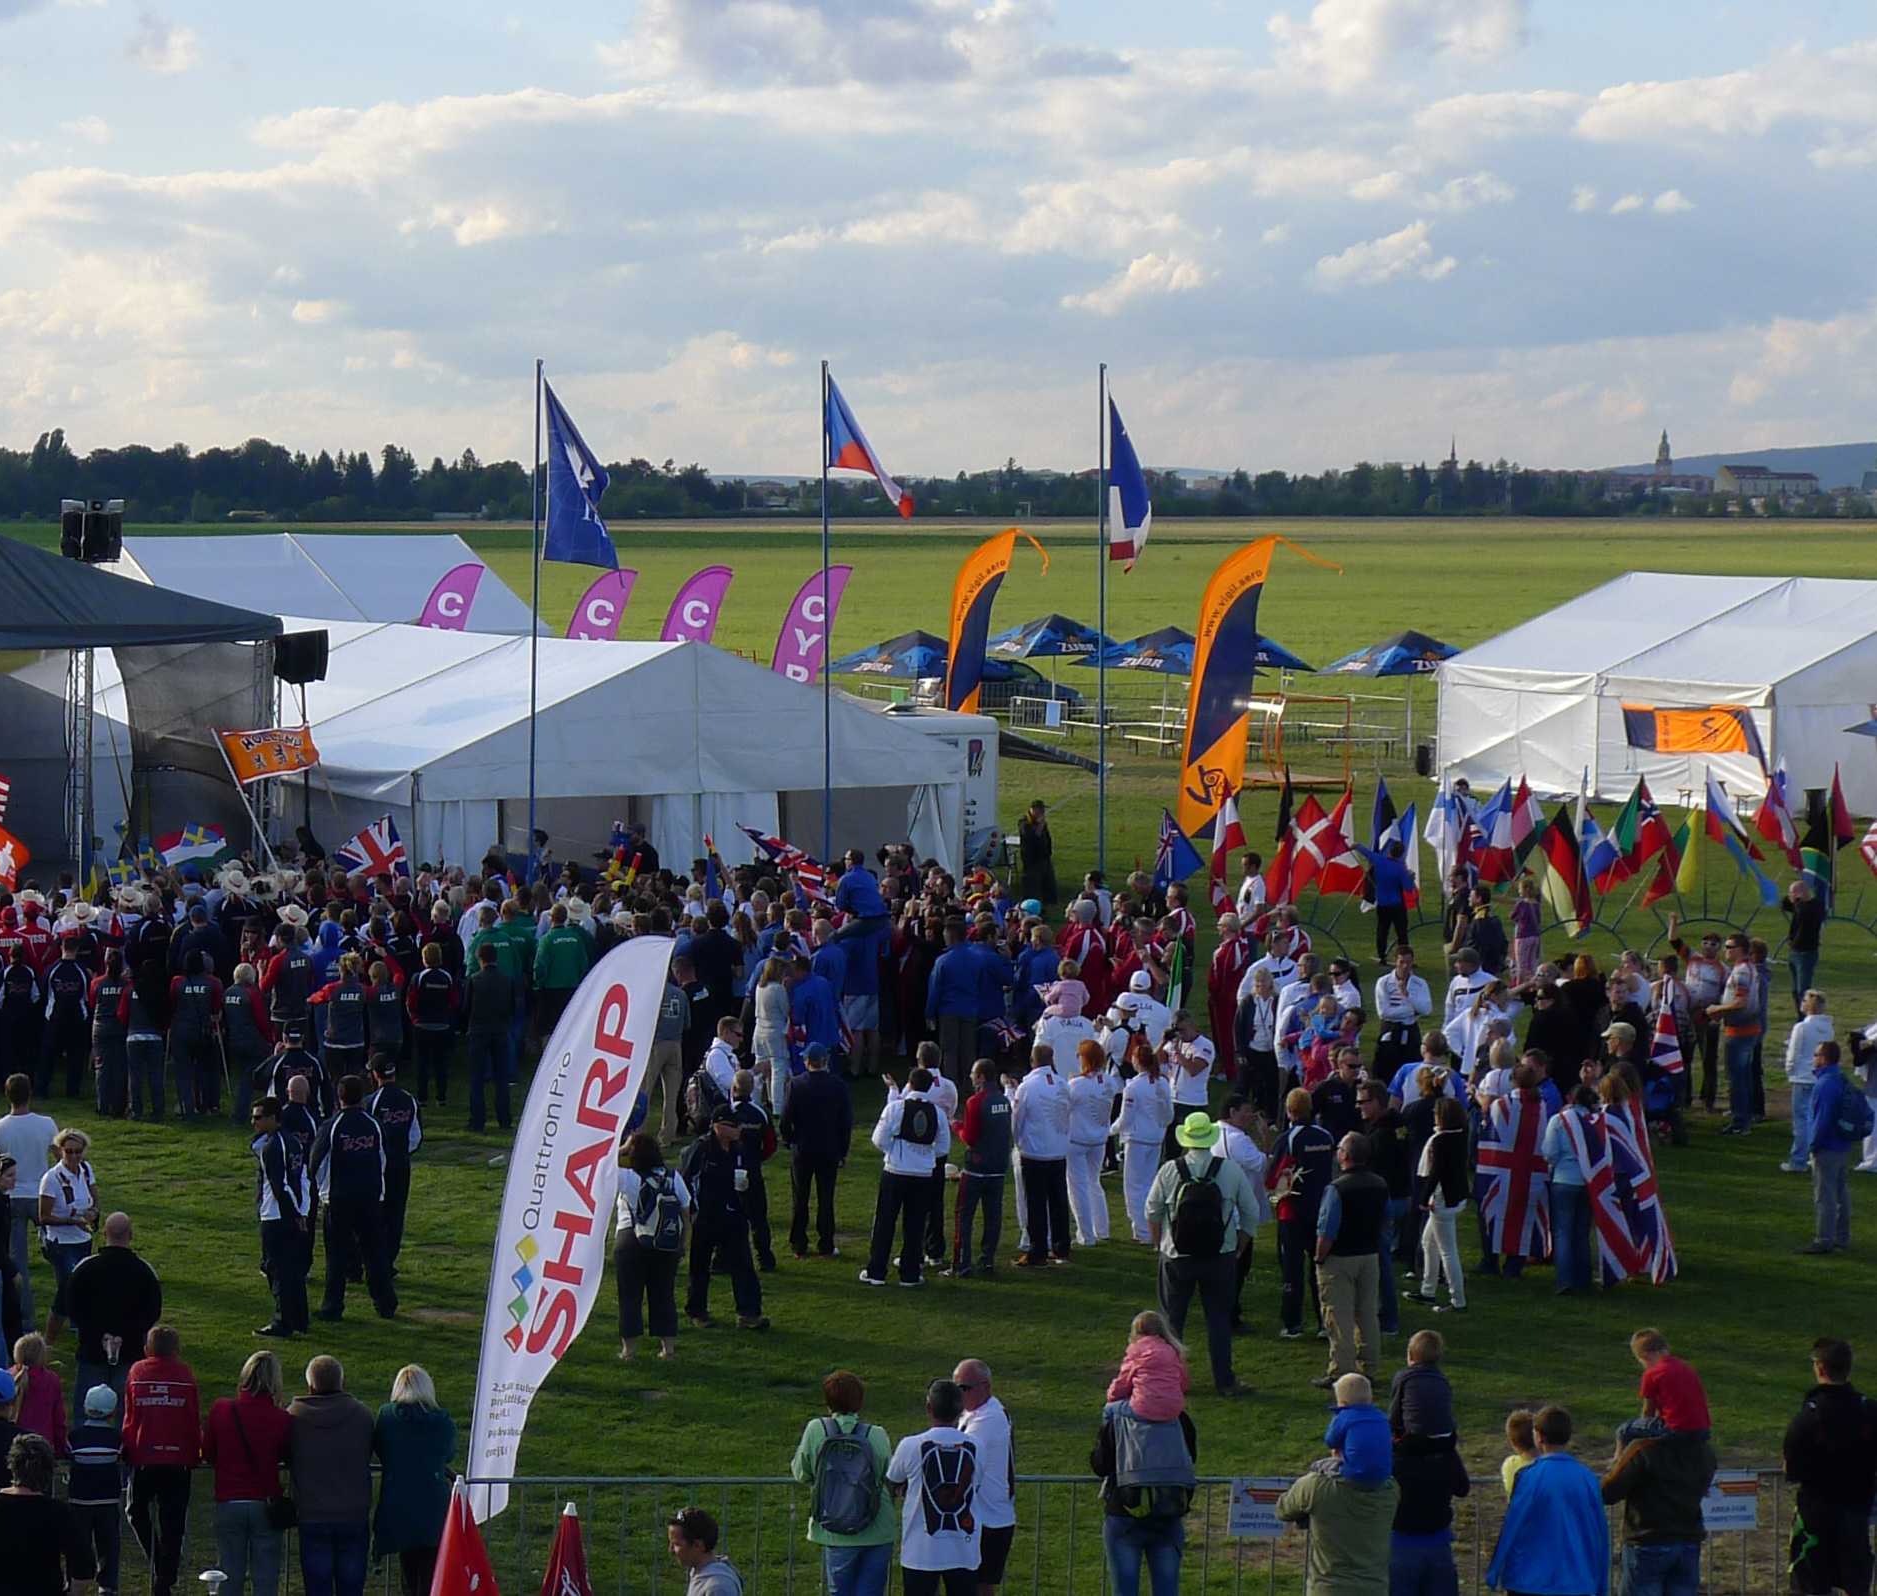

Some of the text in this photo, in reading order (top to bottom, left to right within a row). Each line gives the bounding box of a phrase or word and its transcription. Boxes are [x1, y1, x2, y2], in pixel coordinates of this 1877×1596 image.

[1117, 656, 1164, 668] ZUBR
[522, 1051, 572, 1231] Quattron Pro
[525, 982, 635, 1361] SHARP
